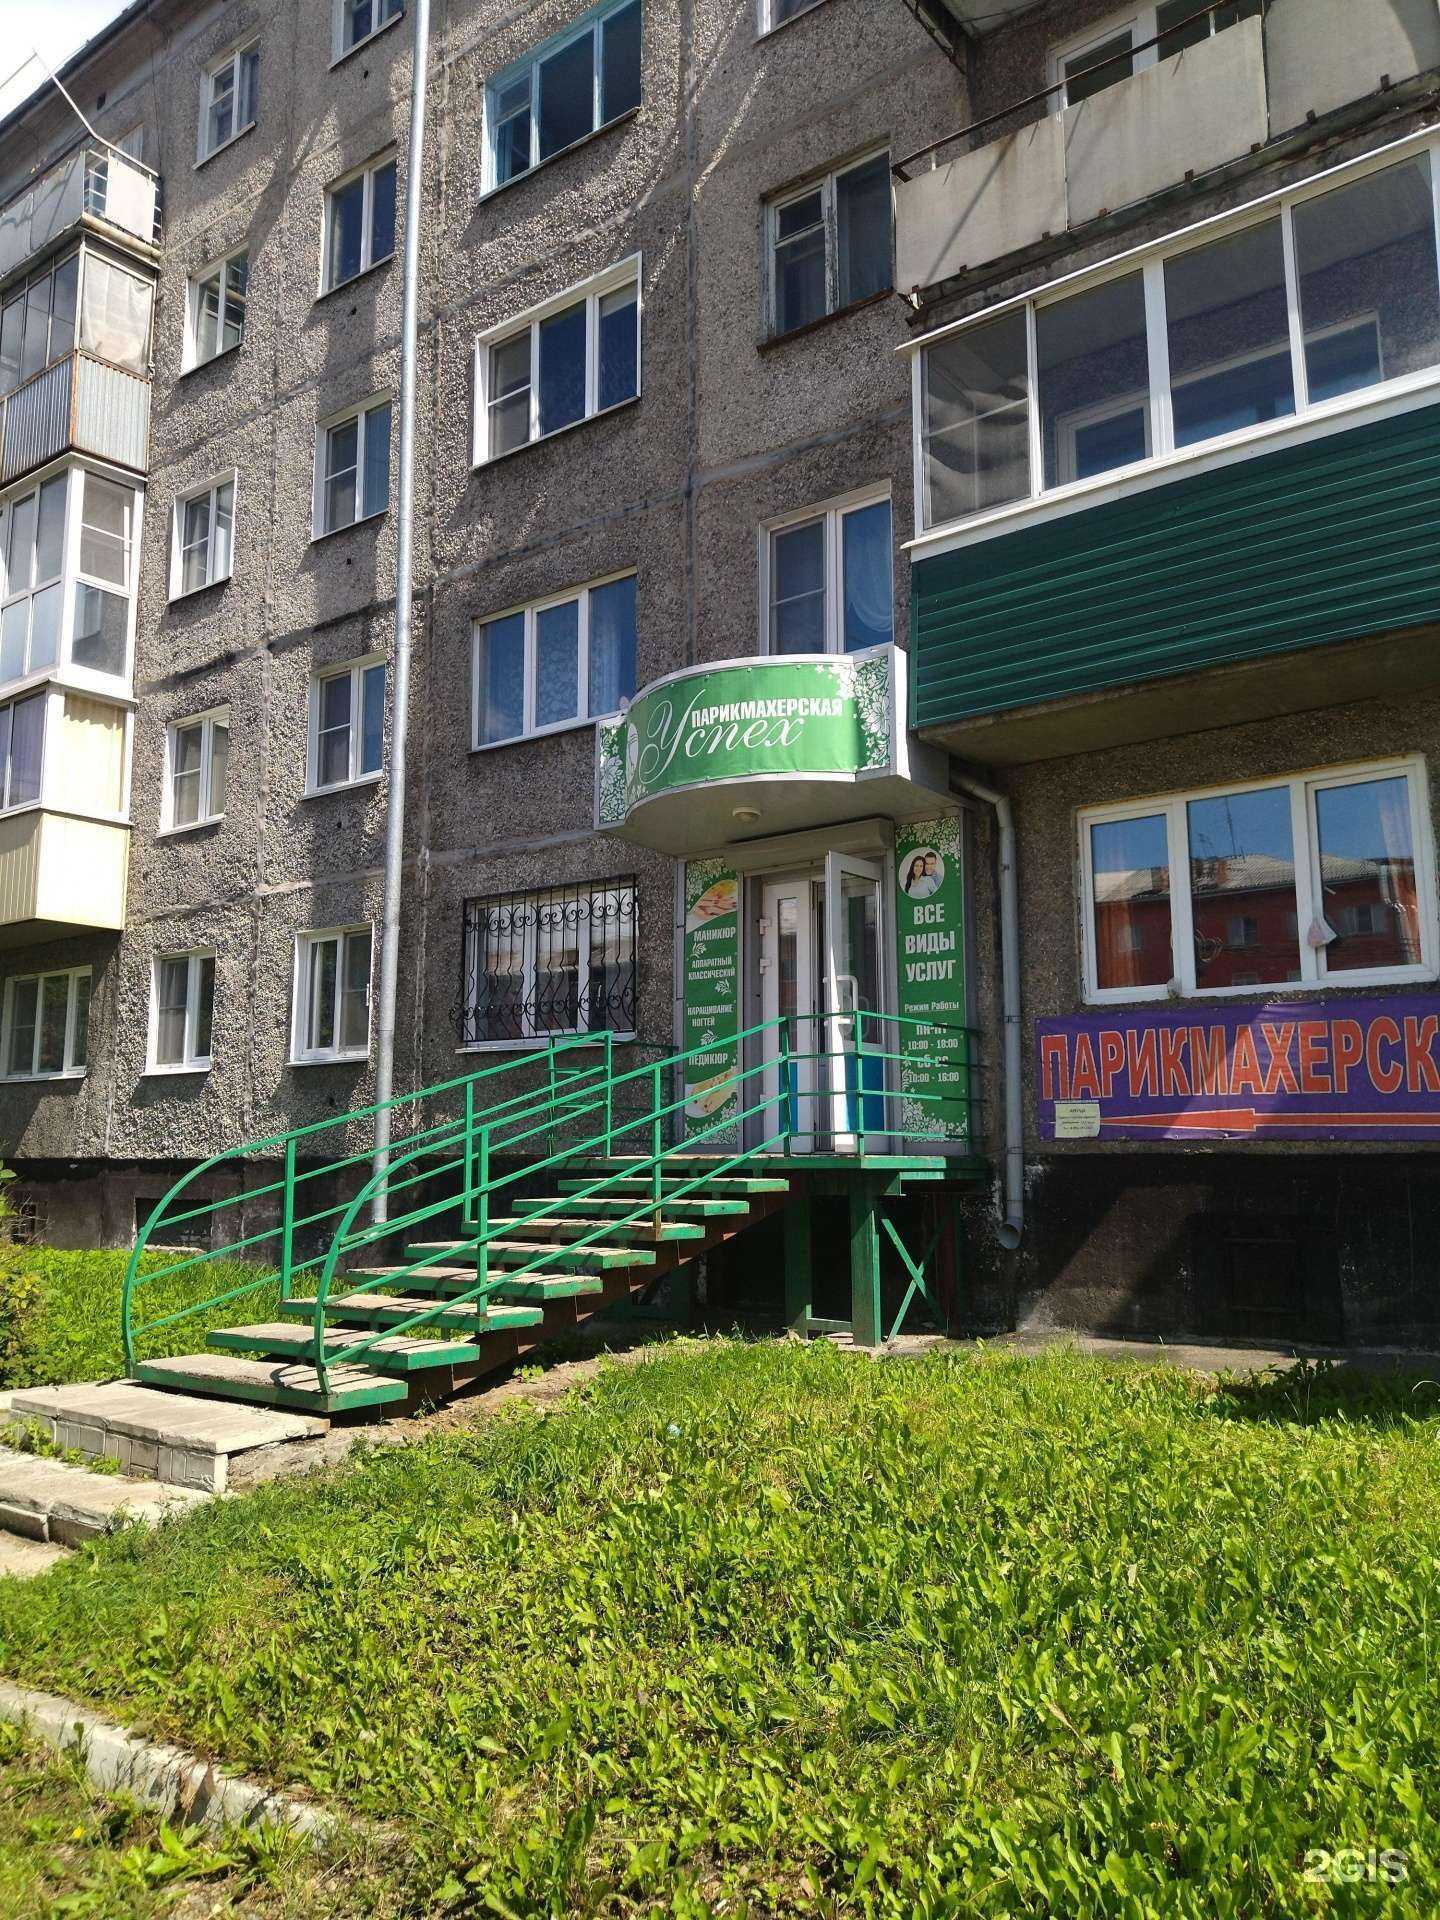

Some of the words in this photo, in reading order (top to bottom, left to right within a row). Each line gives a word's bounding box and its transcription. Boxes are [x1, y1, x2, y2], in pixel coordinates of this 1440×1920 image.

[691, 697, 843, 728] ПАРИКМАХЕРСКАЯ
[638, 688, 805, 784] Успех
[913, 903, 945, 925] ВСЕ
[693, 926, 736, 942] МАНИКЮР
[905, 930, 956, 955] ВИДЫ
[691, 955, 733, 969] АППАРАТНЫЙ
[688, 967, 736, 981] КЛАССИЧЕСКИЙ
[905, 959, 957, 983] УСЛУГ
[687, 1003, 733, 1016] НАРАЩИВАНИЕ
[692, 1015, 716, 1027] НОГТЕЙ
[907, 1040, 929, 1050] 10:00
[936, 1039, 959, 1049] 18:00
[688, 1053, 728, 1067] ПЕДИКЮР
[1040, 1015, 1440, 1099] ПАРИКМАХЕРСК
[908, 1072, 930, 1083] 10:00
[937, 1071, 960, 1082] 16:00
